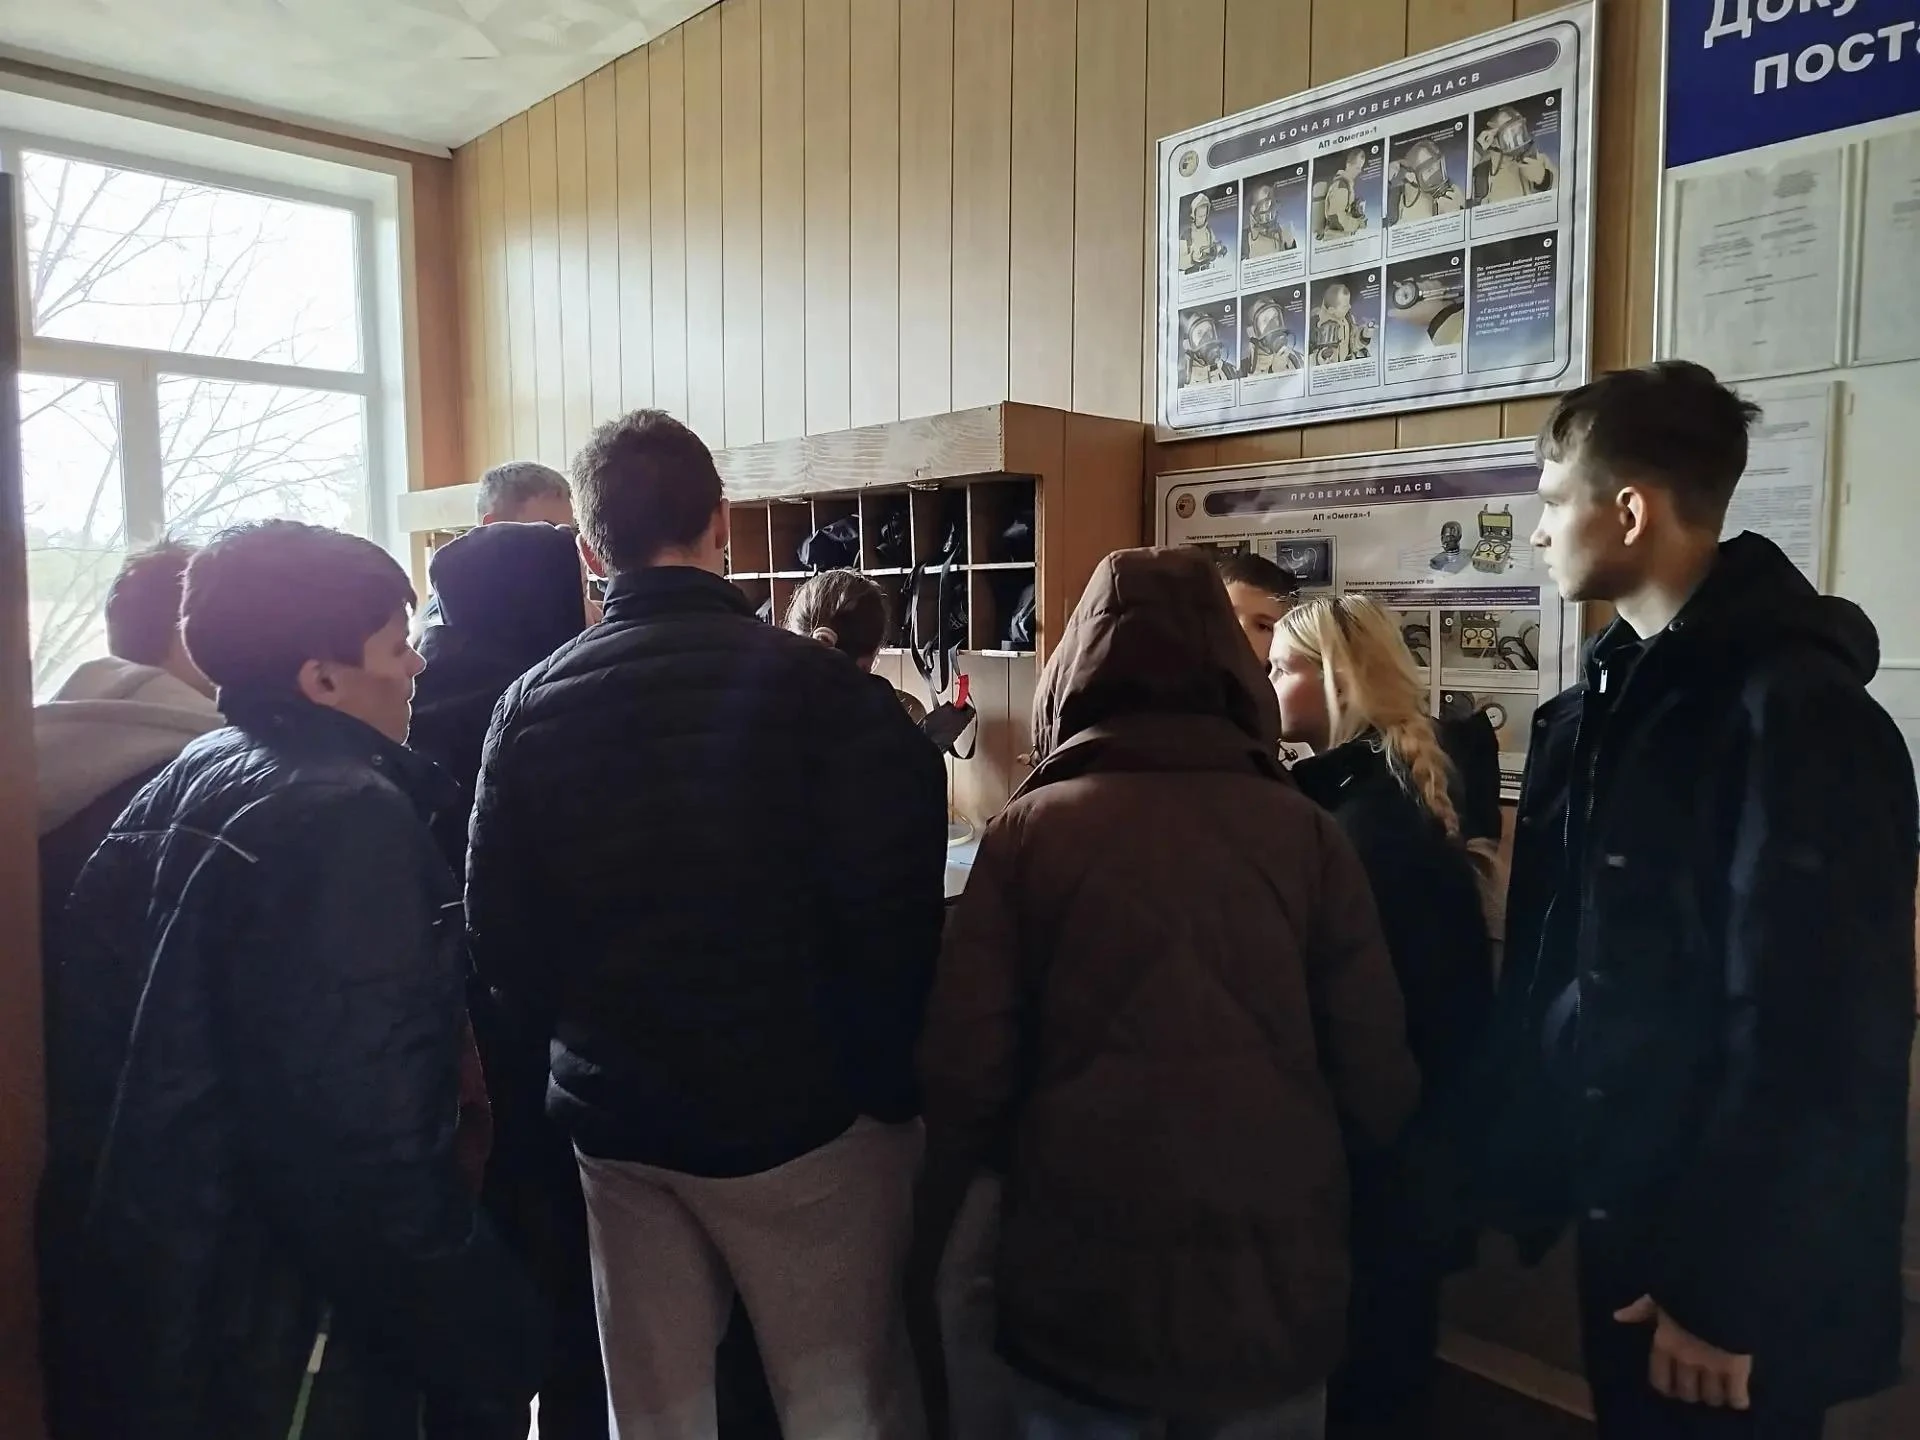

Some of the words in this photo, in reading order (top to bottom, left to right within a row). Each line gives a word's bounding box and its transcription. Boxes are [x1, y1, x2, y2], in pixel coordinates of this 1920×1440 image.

[1753, 21, 1920, 95] пост
[1260, 118, 1331, 147] РАБОЧАЯ
[1336, 89, 1425, 124] ПРОВЕРКА
[1432, 72, 1481, 97] ДАСВ
[1318, 138, 1331, 150] АП
[1291, 489, 1360, 501] ПРОВЕРКА
[1393, 482, 1432, 494] ДАСВ
[1312, 513, 1325, 522] АП
